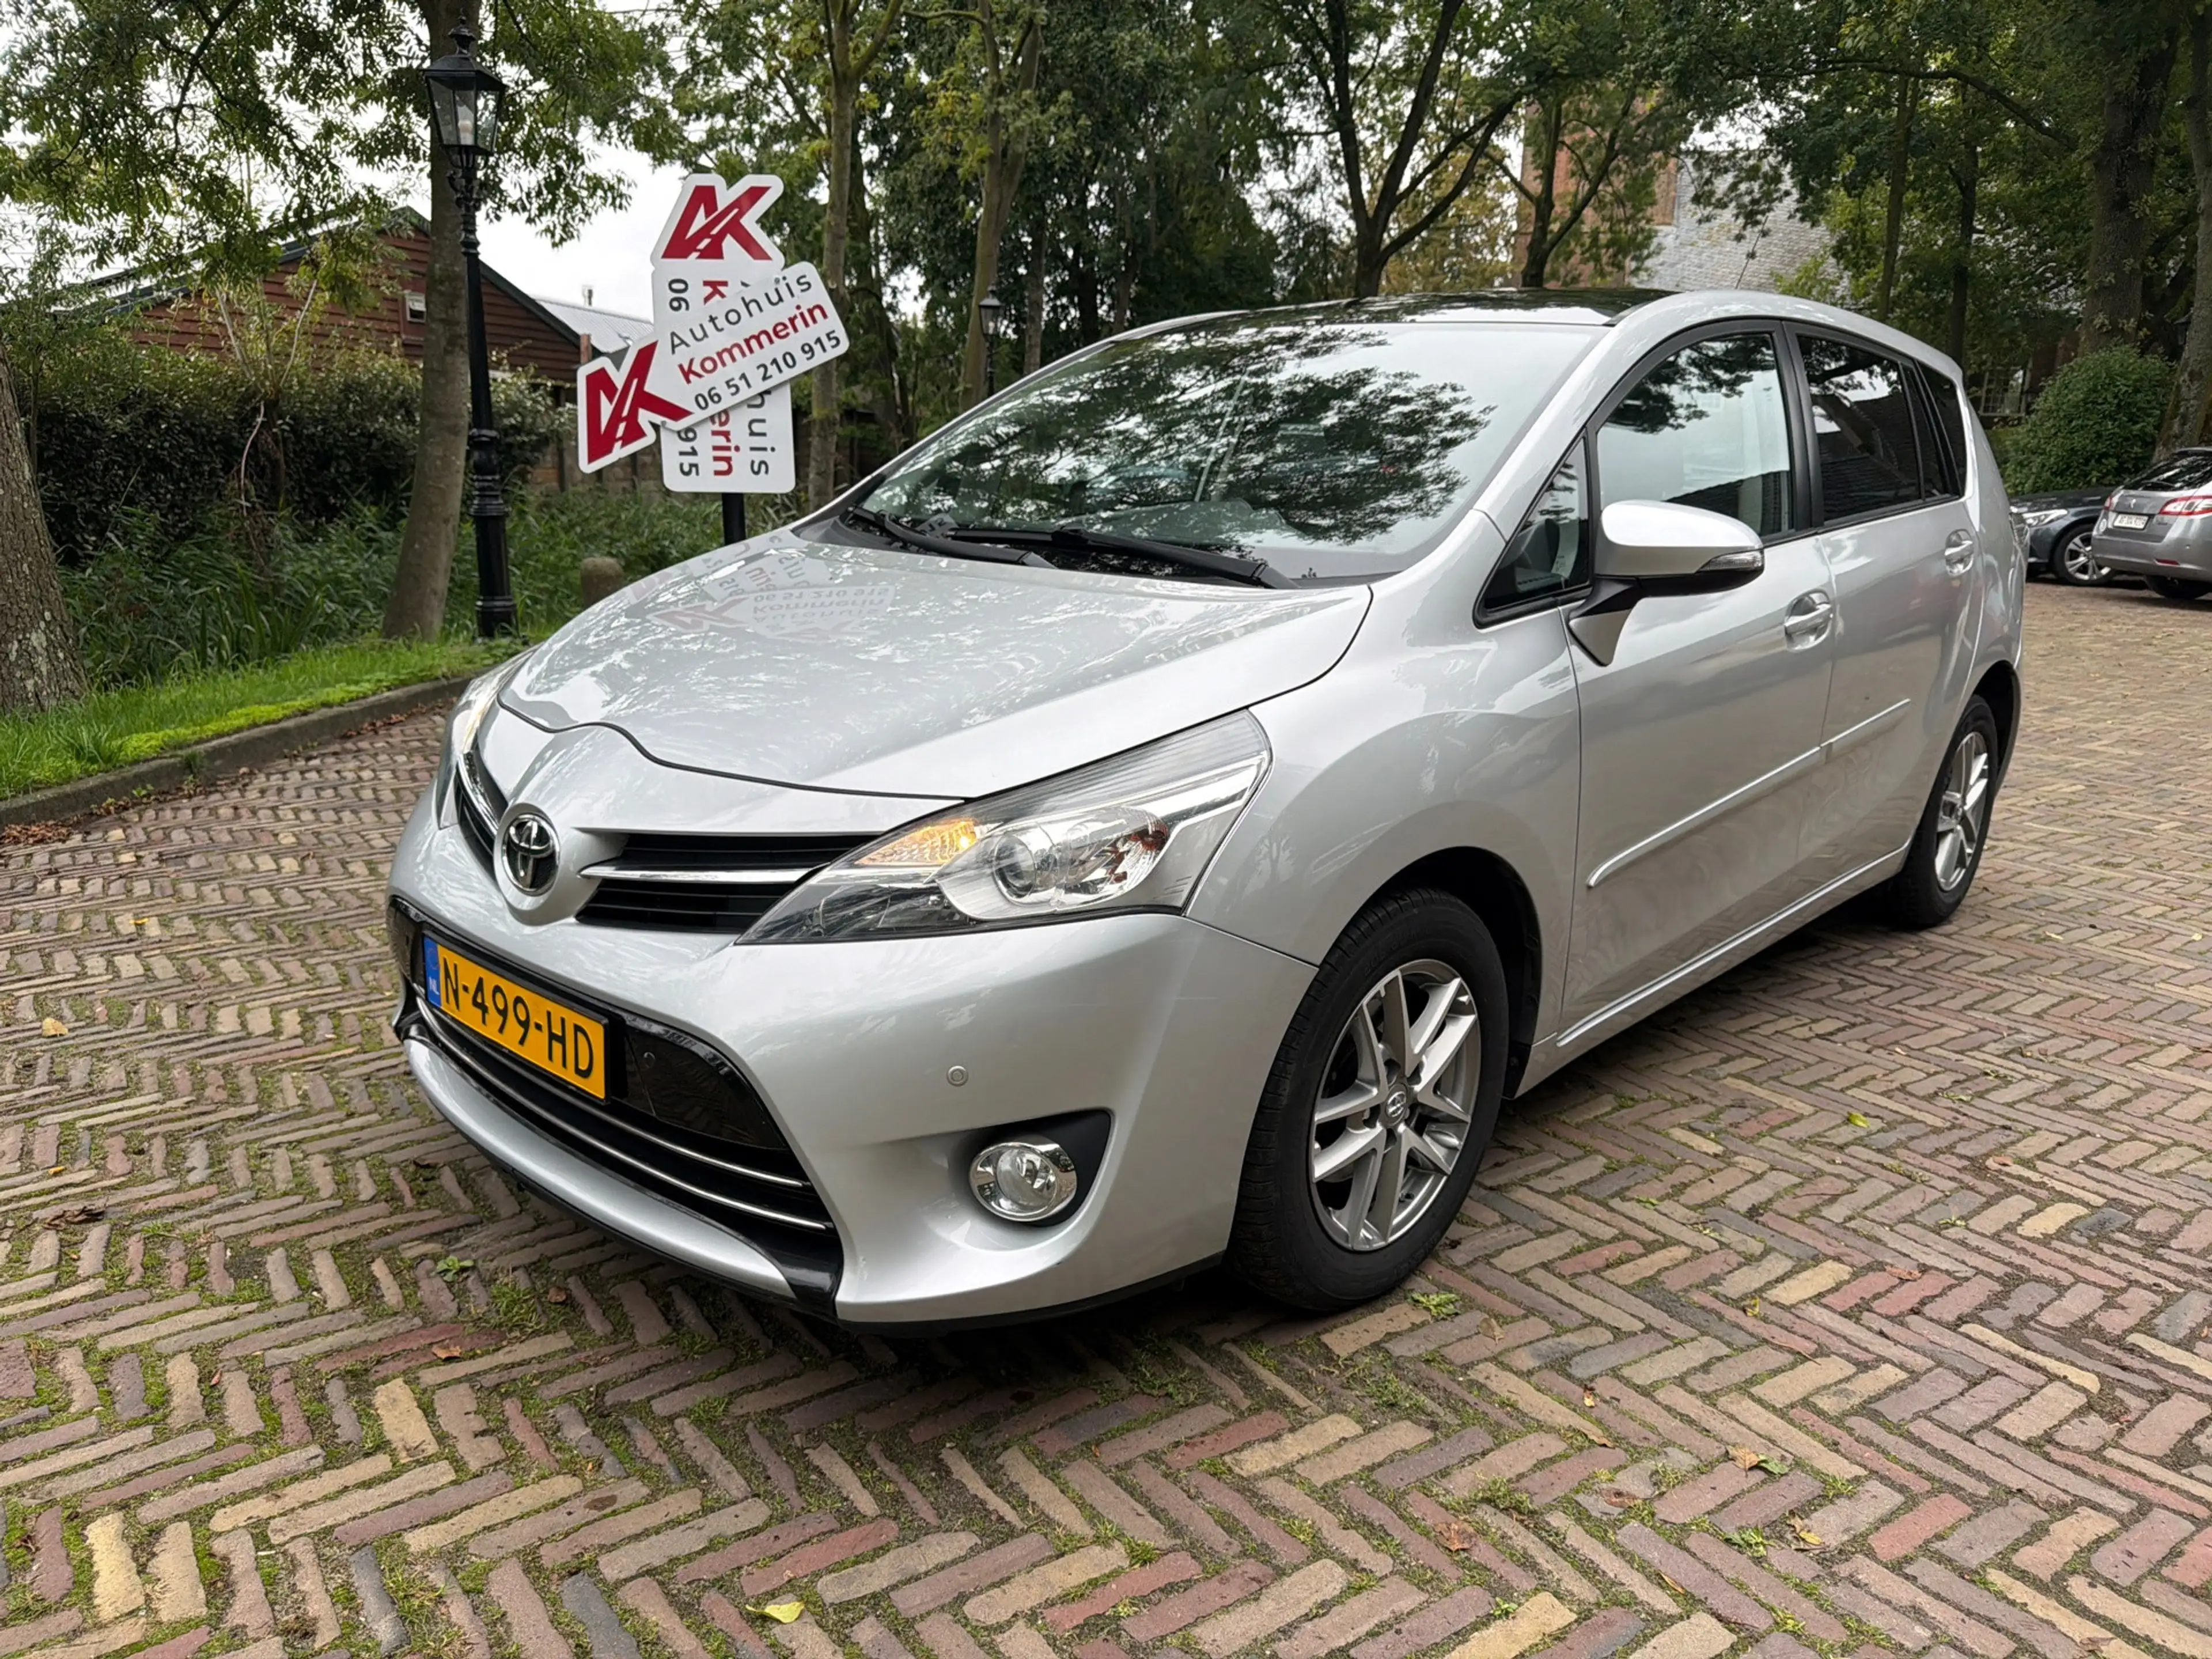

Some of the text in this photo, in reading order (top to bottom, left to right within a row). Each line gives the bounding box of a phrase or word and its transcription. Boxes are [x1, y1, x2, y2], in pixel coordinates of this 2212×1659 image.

[668, 278, 690, 312] 06
[669, 274, 812, 355] Autohuis
[703, 281, 729, 305] K
[677, 304, 828, 385] Kommerin
[694, 329, 841, 410] 06 51 210 915
[677, 427, 700, 477] 915
[709, 408, 741, 476] erin
[747, 389, 776, 476] huis
[429, 976, 440, 996] NL
[443, 956, 594, 1078] N-499-HD
